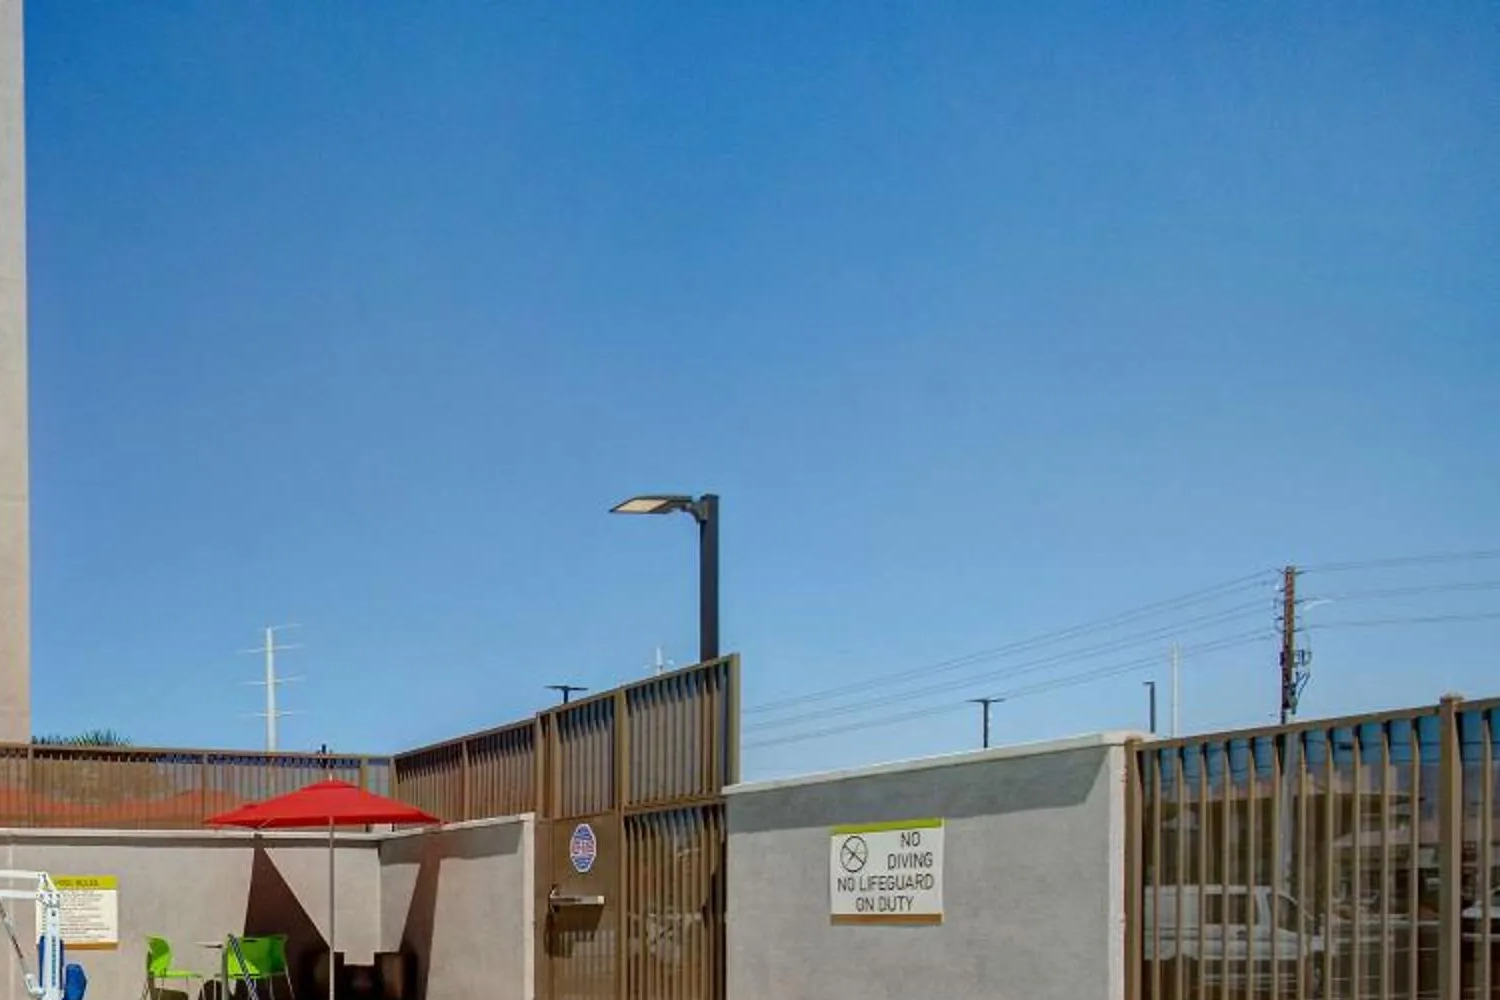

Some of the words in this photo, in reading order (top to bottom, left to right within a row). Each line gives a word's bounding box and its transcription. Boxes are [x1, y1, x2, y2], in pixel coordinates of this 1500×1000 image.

[900, 832, 921, 848] NO
[887, 852, 933, 870] DIVING
[837, 877, 854, 892] NO
[859, 873, 934, 892] LIFEGUARD
[856, 897, 874, 912] ON
[878, 896, 914, 913] DUTY
